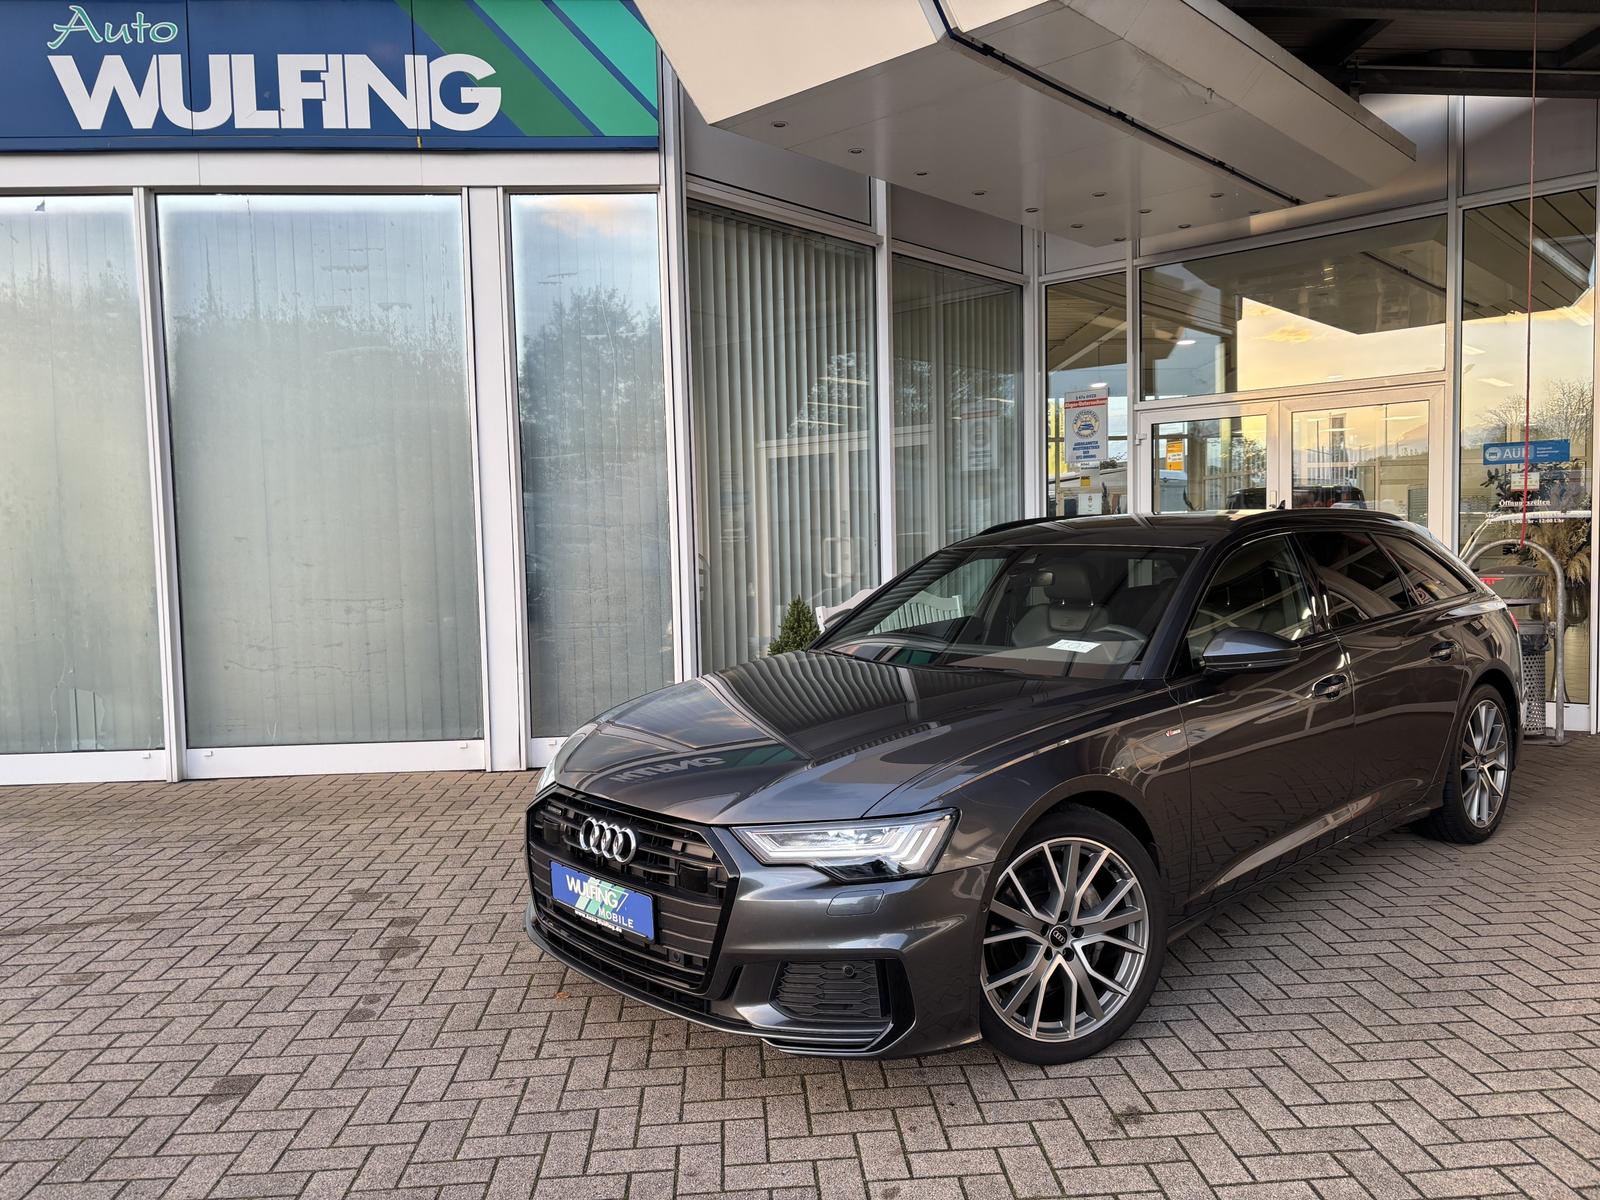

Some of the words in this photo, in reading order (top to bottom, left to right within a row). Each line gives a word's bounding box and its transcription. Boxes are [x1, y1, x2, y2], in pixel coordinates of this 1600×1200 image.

[46, 4, 179, 50] Auto
[47, 52, 502, 132] WULFING
[1499, 499, 1551, 508] Öffnunszeiten
[565, 874, 619, 909] WULFING
